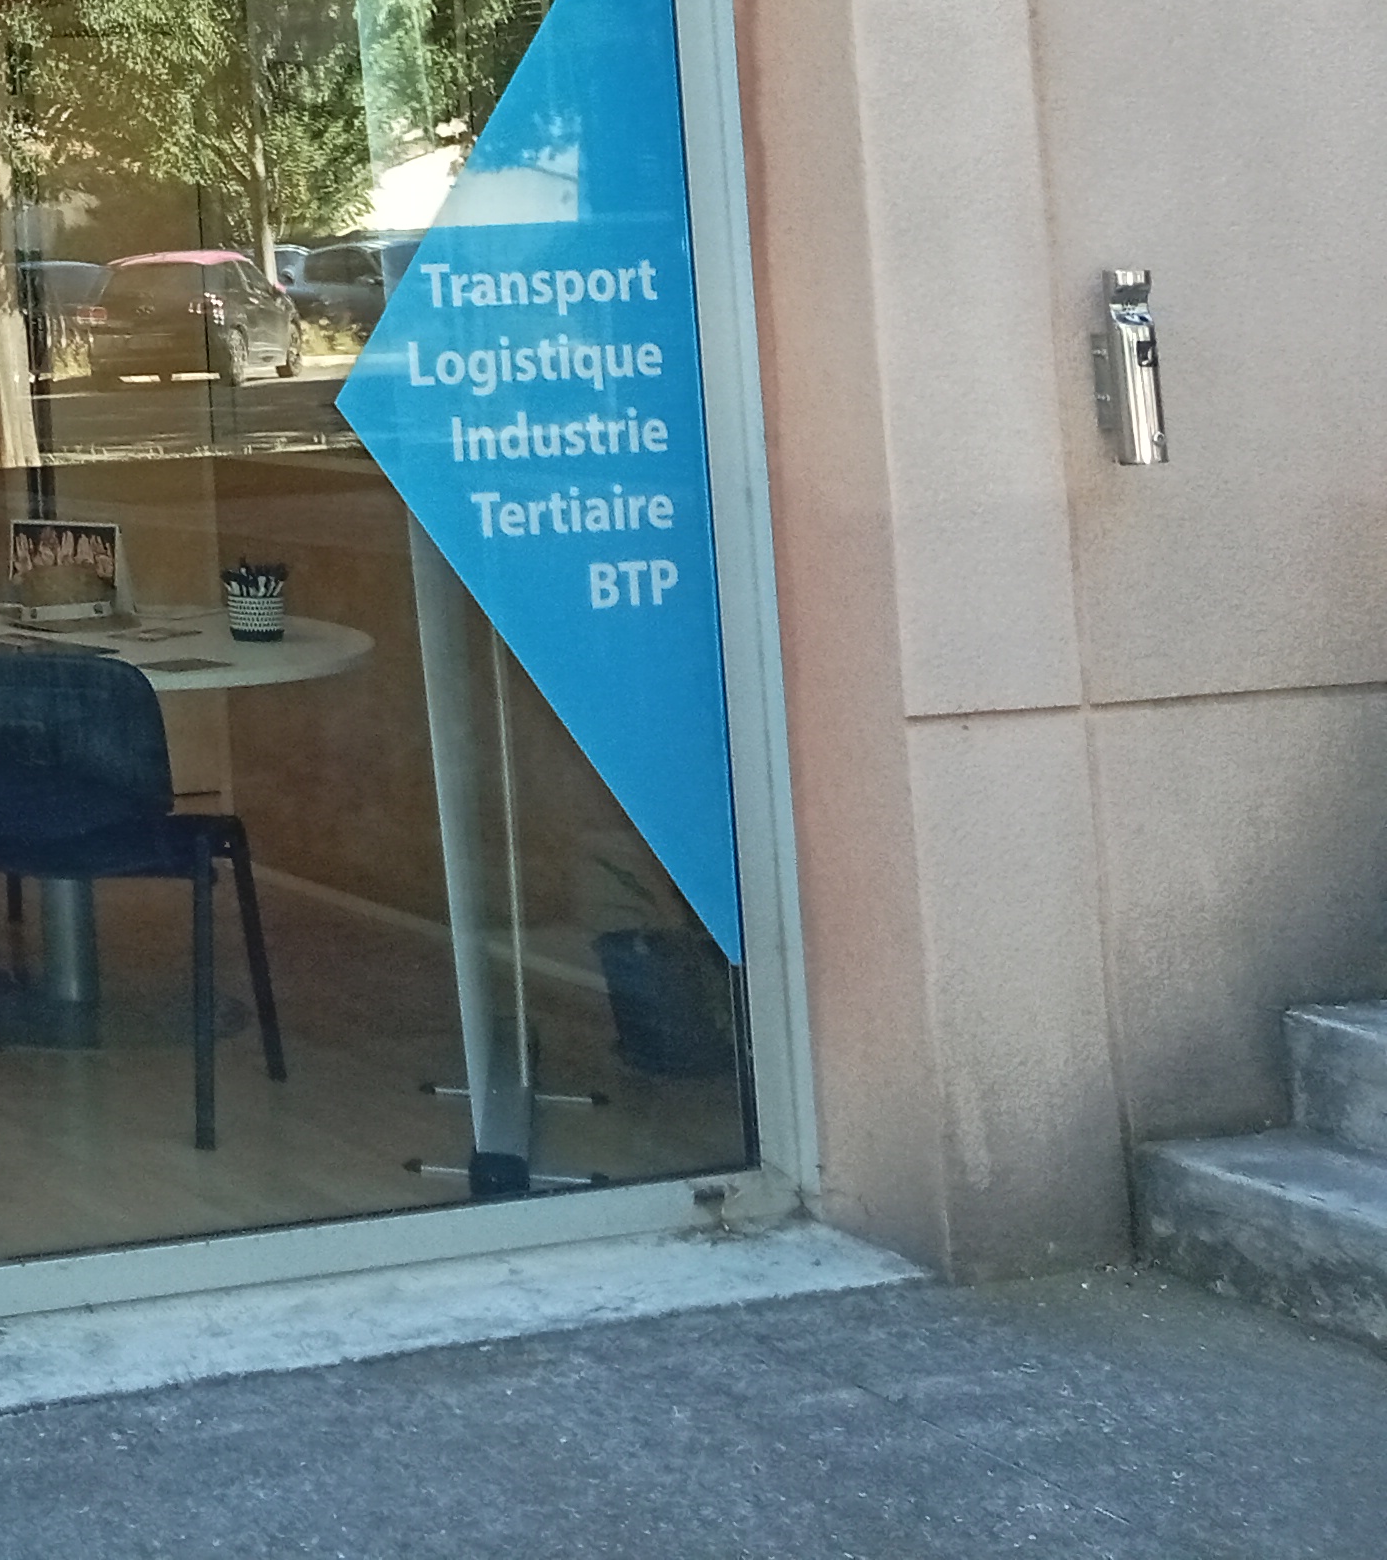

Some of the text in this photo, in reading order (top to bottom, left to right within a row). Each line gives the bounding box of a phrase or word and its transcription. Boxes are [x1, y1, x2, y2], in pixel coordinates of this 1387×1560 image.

[419, 259, 659, 317] Transport
[407, 334, 663, 397] Logistique
[451, 406, 669, 463] Industrie
[470, 483, 675, 539] Tertiaire
[588, 558, 680, 610] BTP
